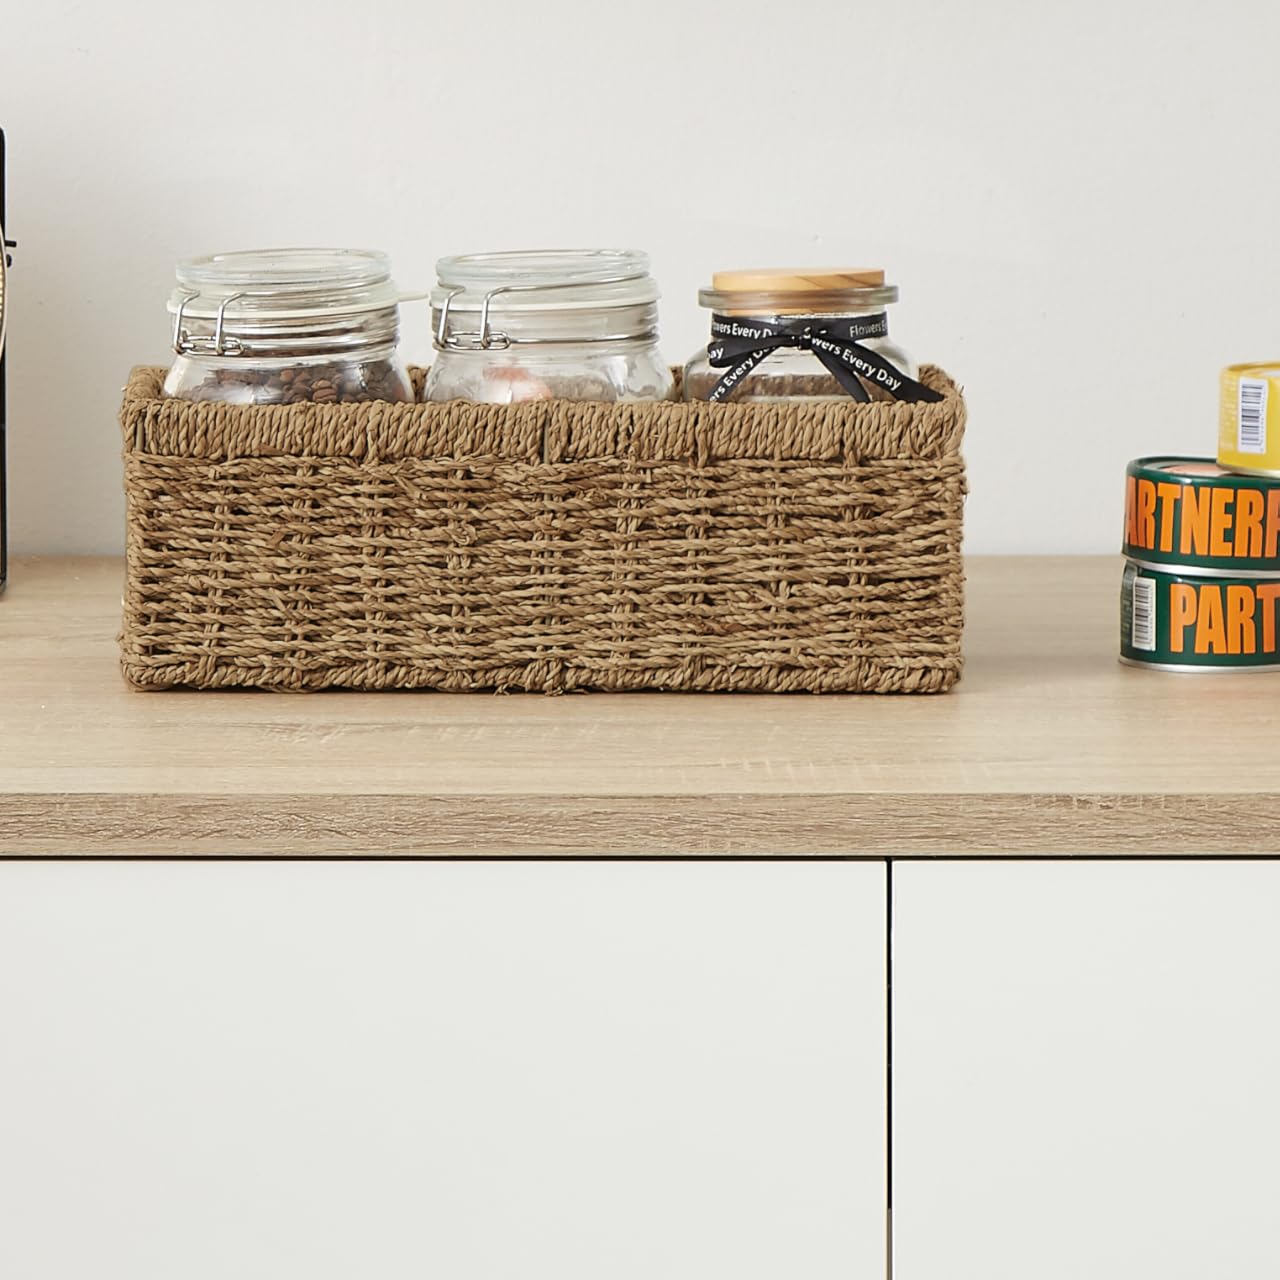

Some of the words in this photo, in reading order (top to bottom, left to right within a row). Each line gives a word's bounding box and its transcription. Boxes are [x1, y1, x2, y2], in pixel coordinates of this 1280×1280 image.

[731, 323, 761, 339] Every
[849, 322, 881, 338] Flowers
[723, 357, 754, 386] Every
[842, 348, 876, 377] Every
[876, 369, 902, 391] Day
